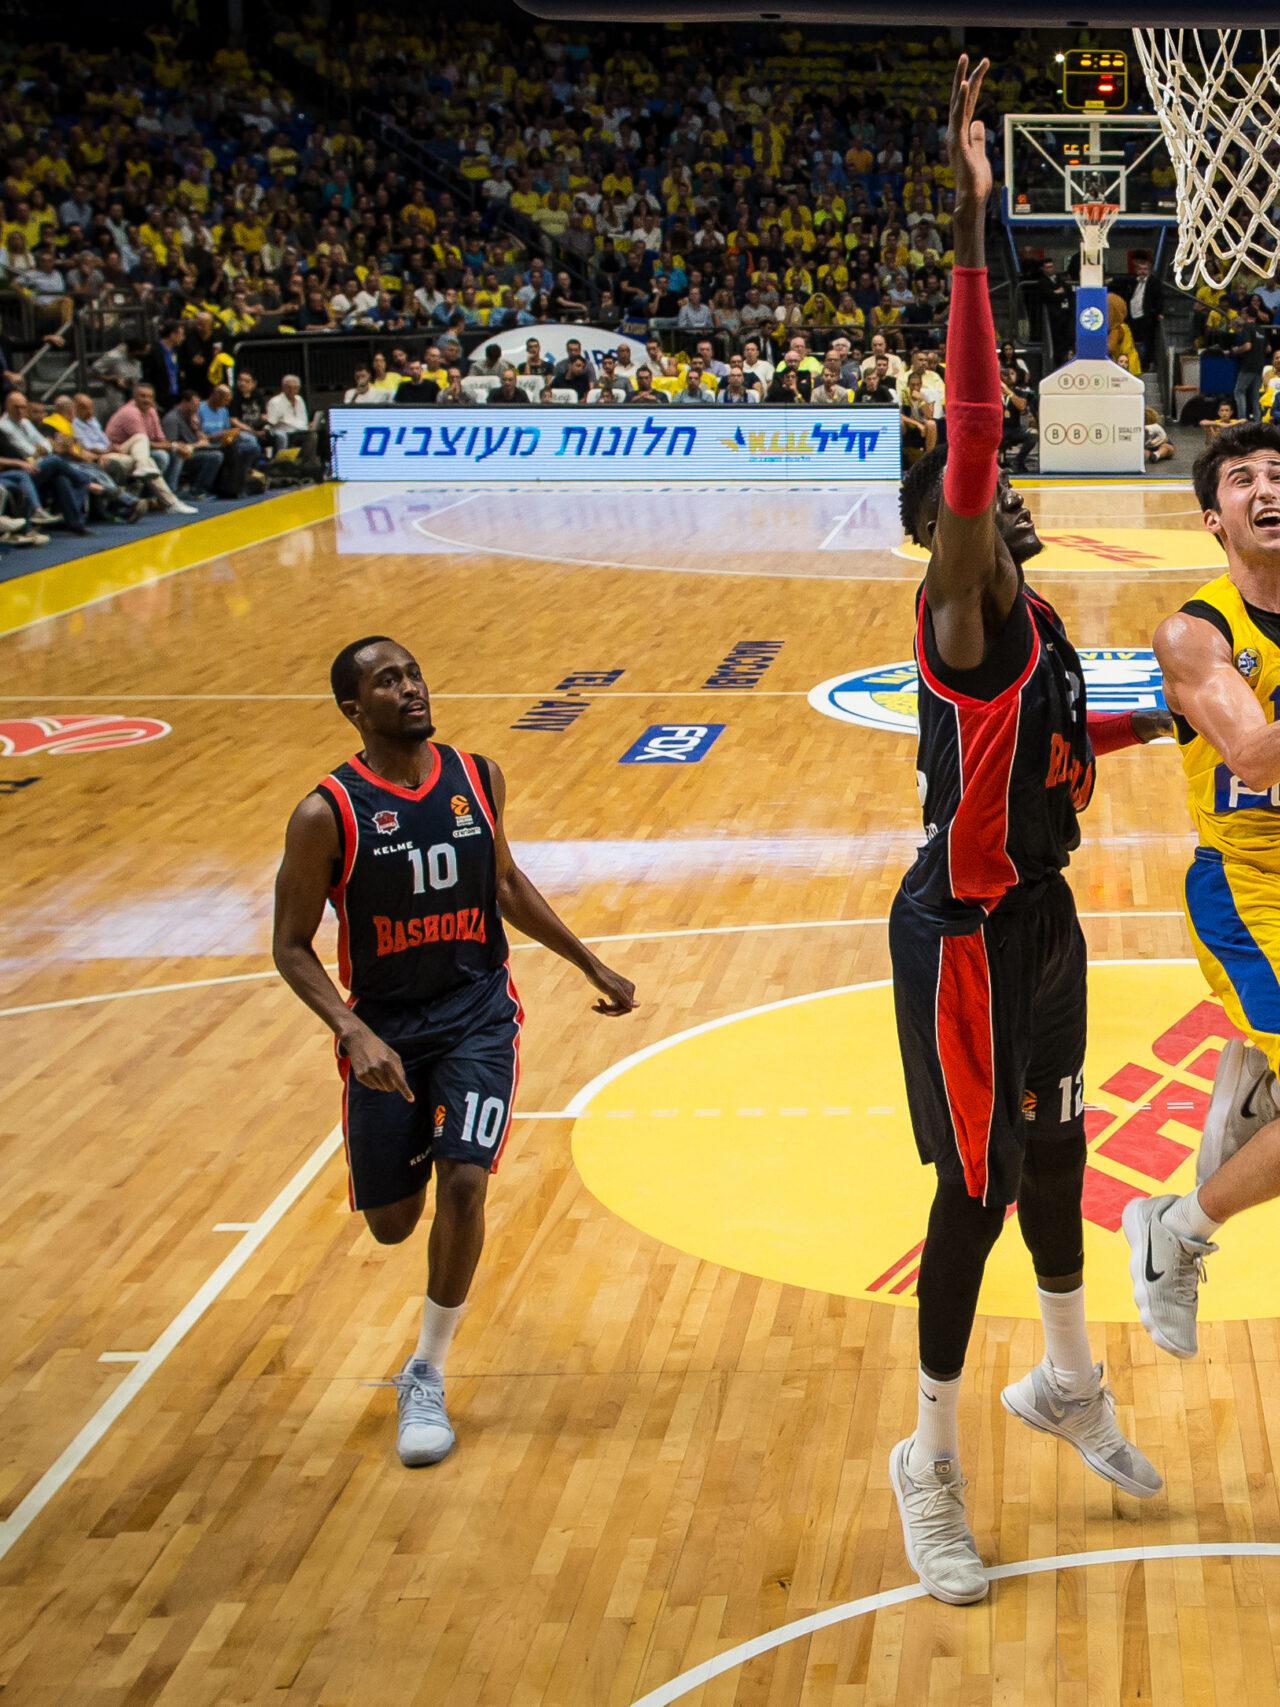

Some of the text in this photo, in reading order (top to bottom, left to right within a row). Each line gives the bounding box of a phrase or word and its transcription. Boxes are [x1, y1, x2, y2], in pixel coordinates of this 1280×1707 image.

[359, 416, 697, 463] חלונות מעוצבים
[810, 422, 881, 462] קליל
[700, 640, 786, 689] MACCABI
[634, 726, 709, 761] FOX
[373, 841, 414, 856] KELME
[408, 842, 460, 894] 10
[461, 1091, 505, 1148] 10
